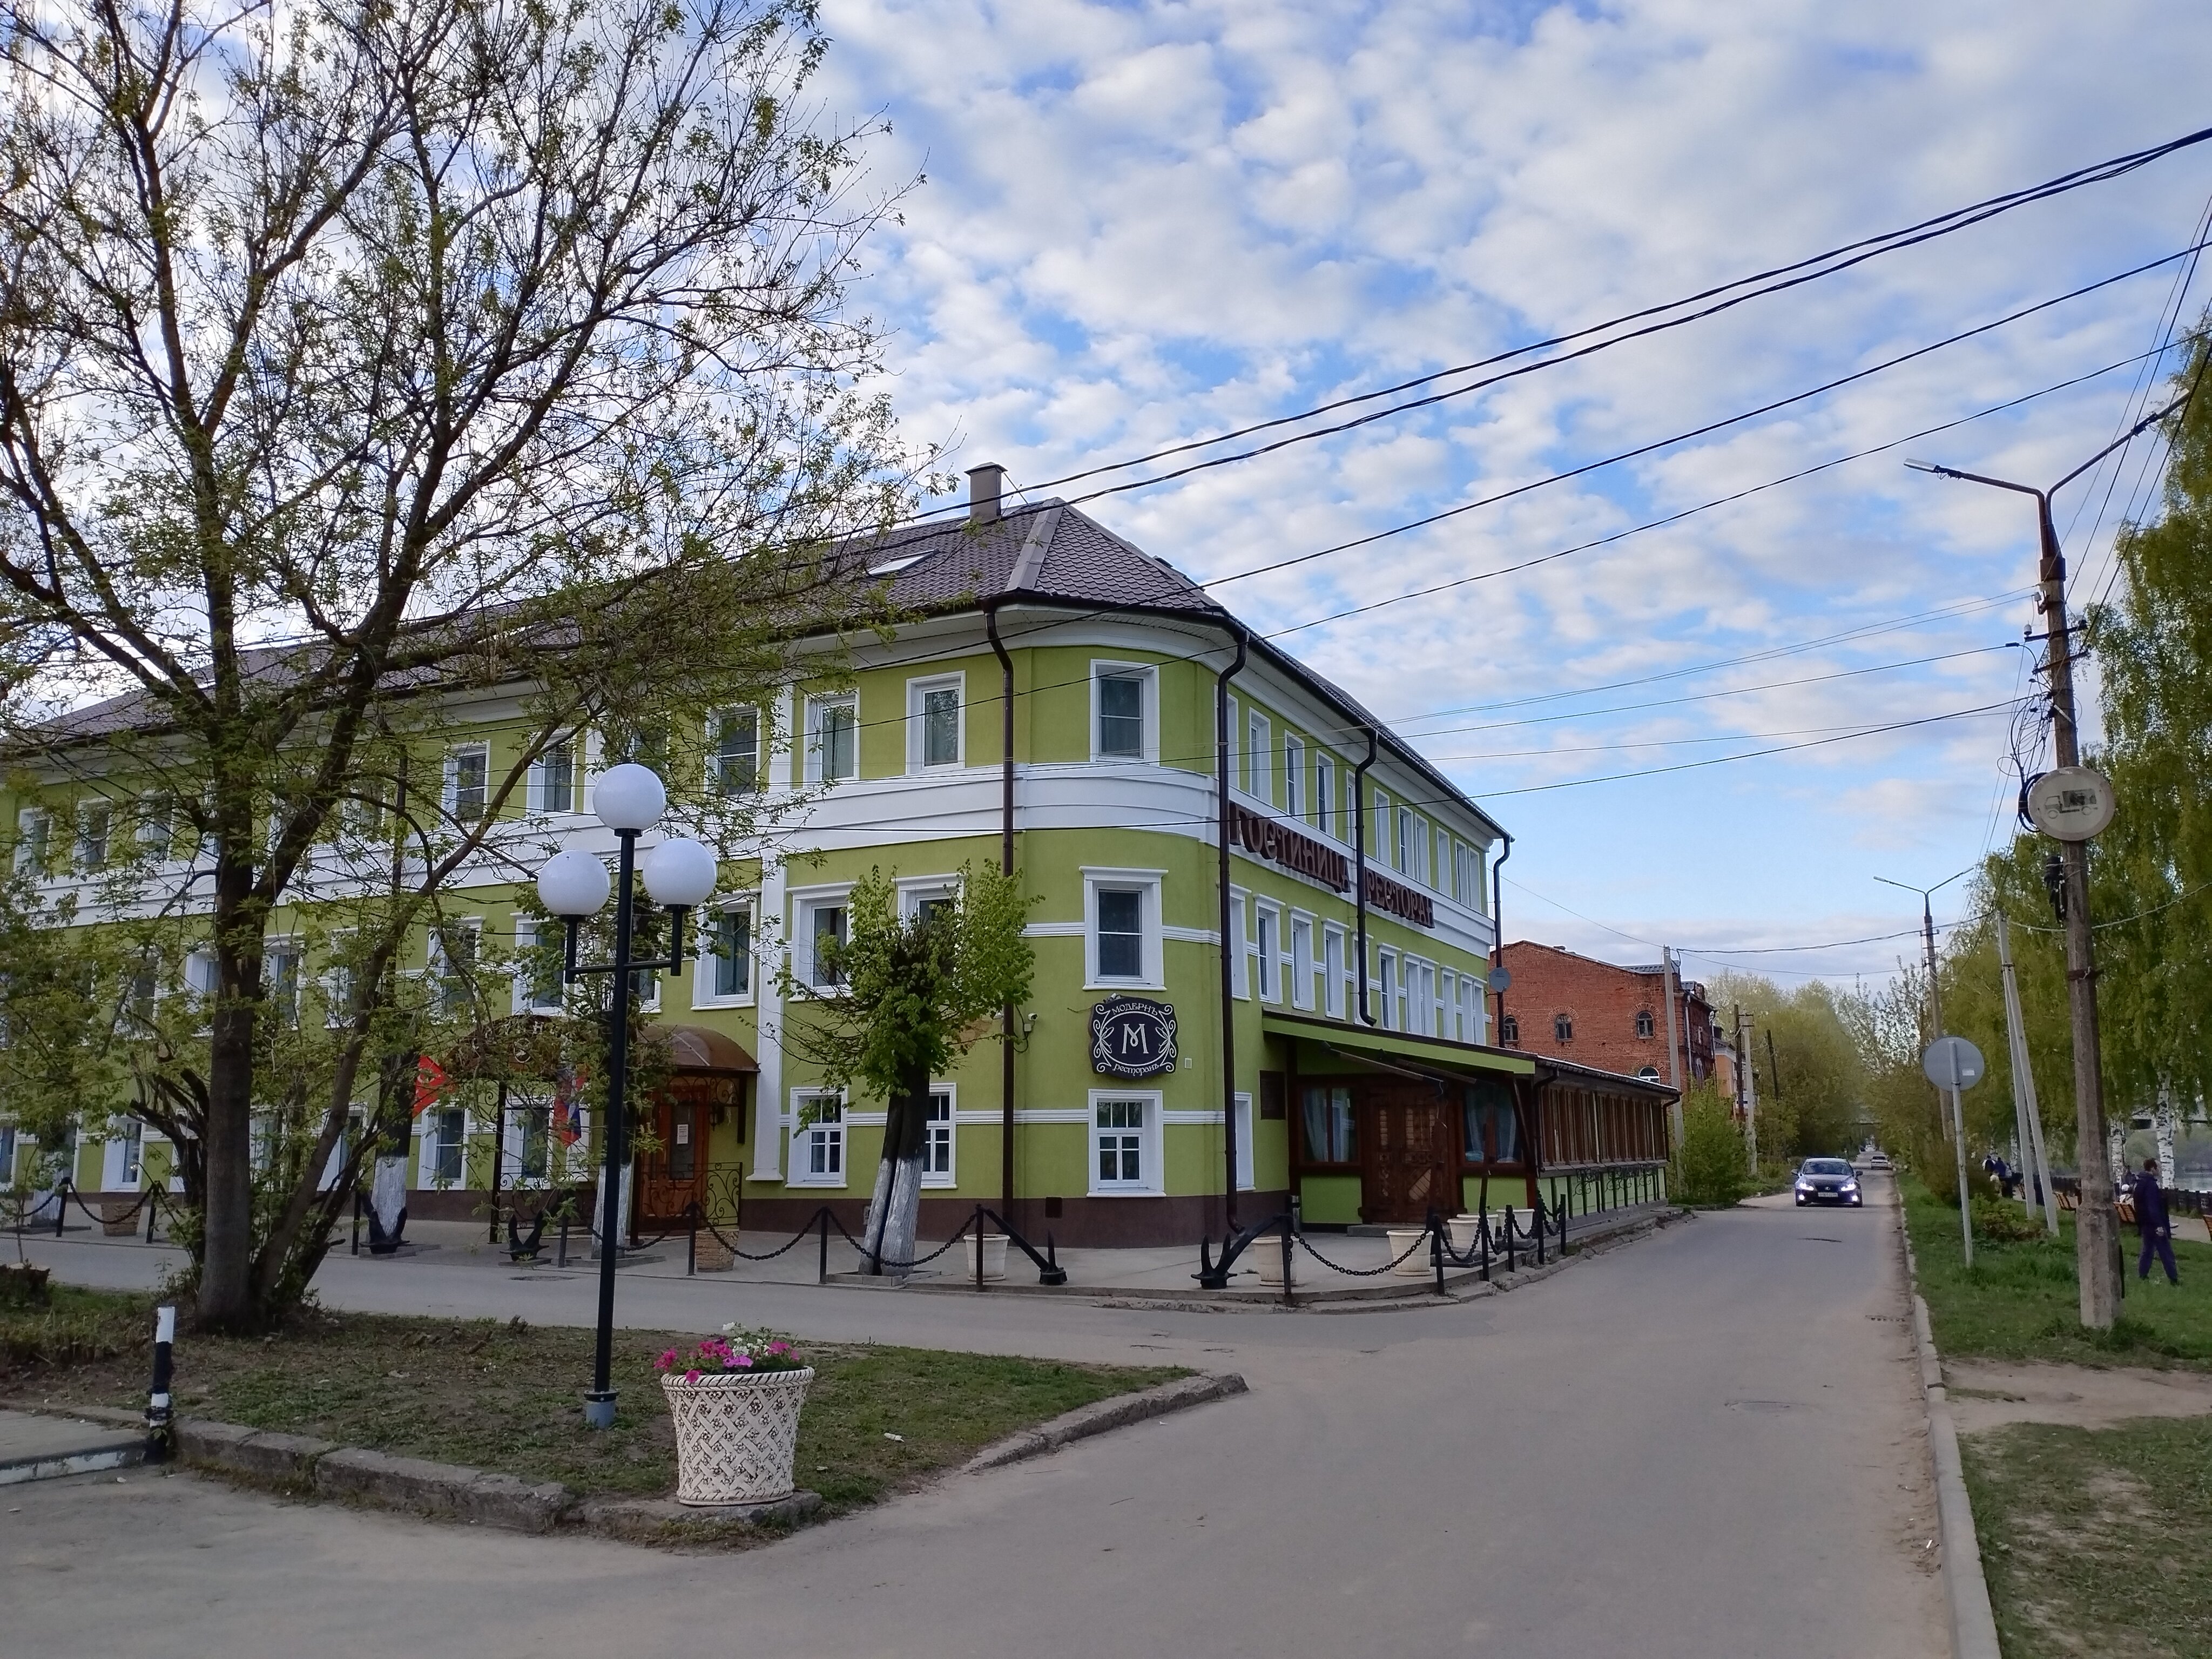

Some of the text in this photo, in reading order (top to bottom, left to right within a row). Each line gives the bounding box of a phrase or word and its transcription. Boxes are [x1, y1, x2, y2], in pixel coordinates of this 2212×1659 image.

[1229, 800, 1435, 929] ГОСТИНИЦА РЕСТОРАН
[1111, 1003, 1158, 1016] МОДЕРНЪ
[1122, 1023, 1149, 1054] М
[1112, 1063, 1159, 1076] ресторанъ
